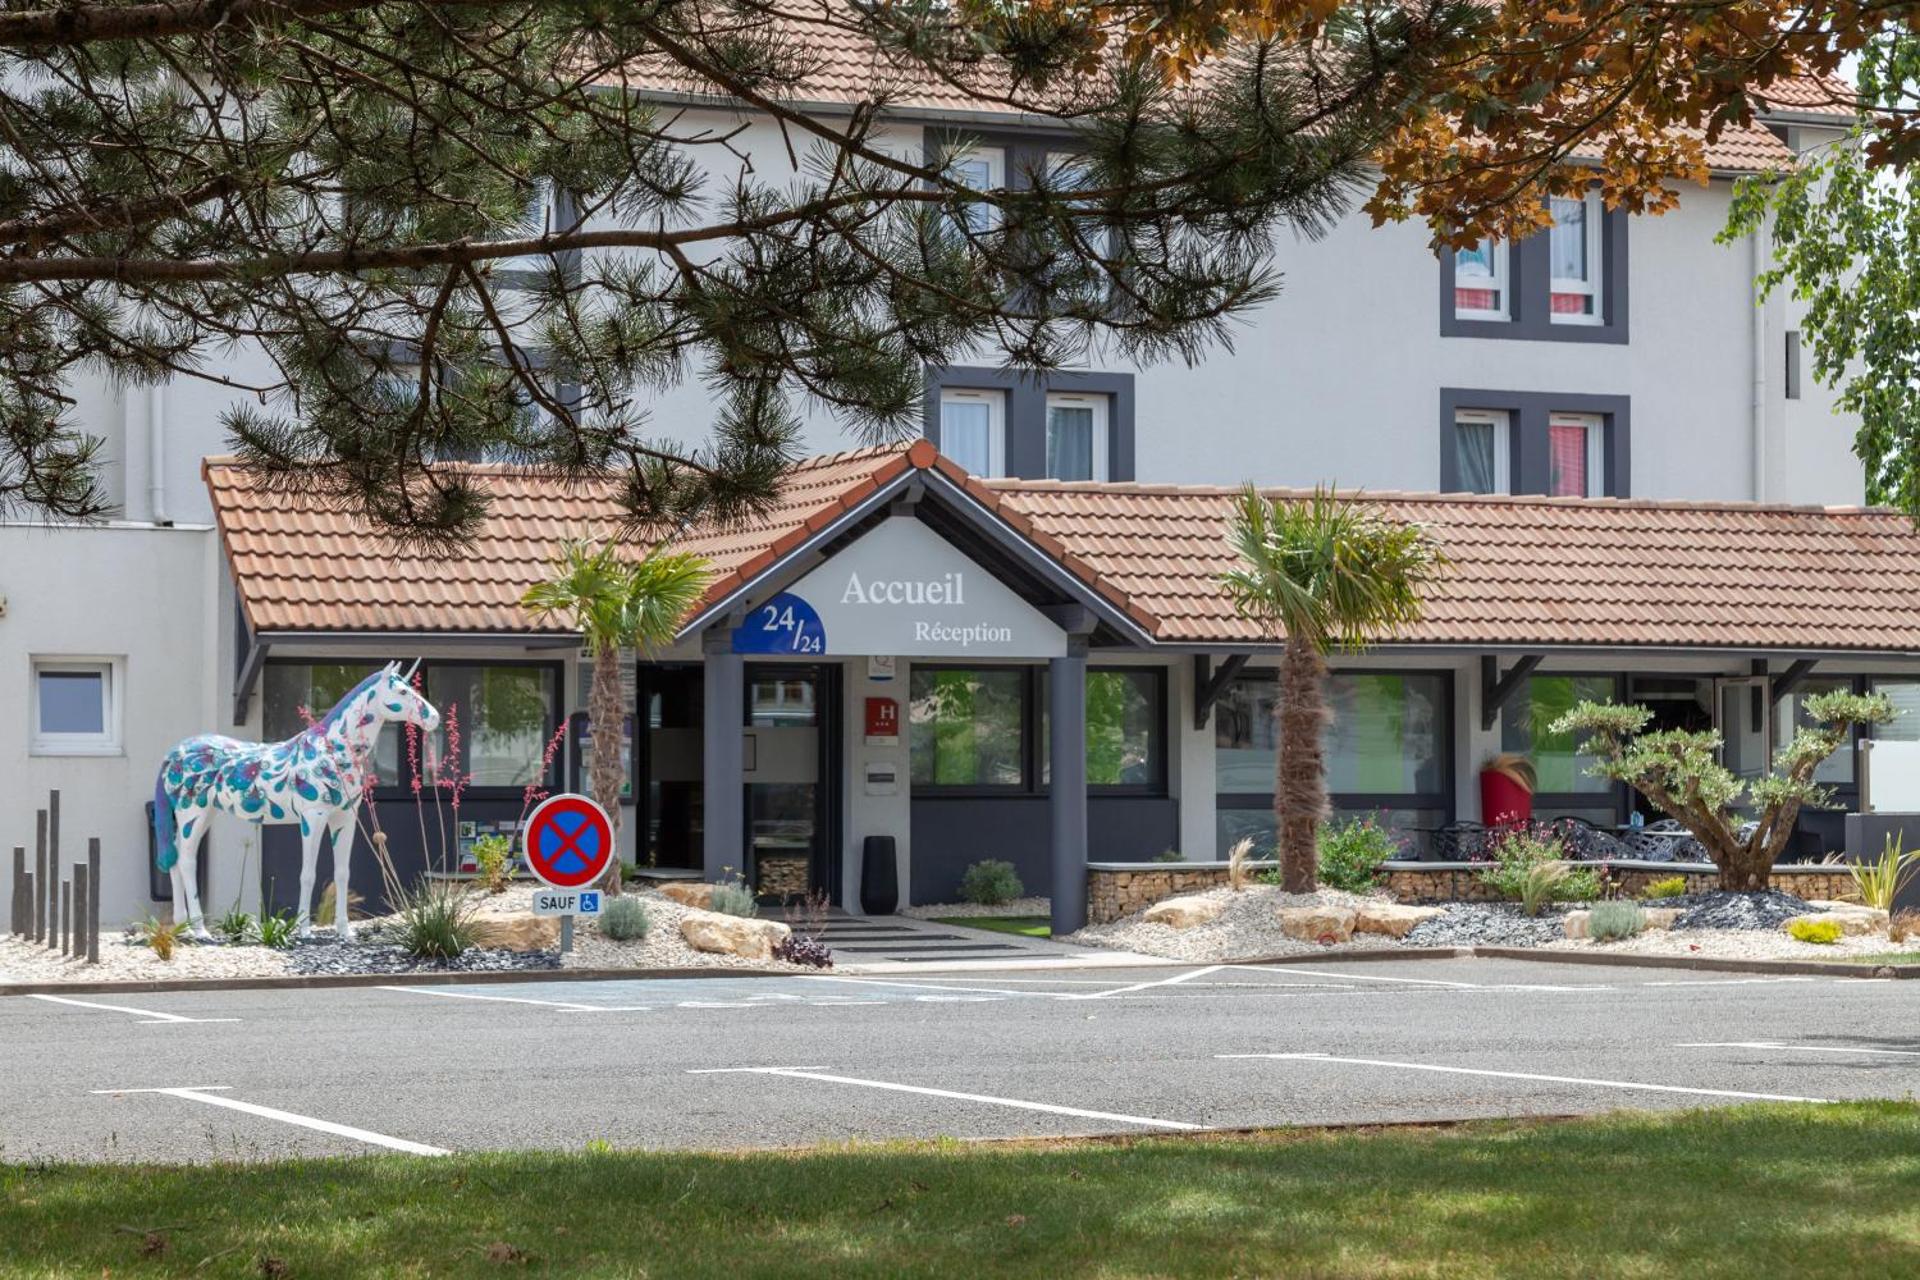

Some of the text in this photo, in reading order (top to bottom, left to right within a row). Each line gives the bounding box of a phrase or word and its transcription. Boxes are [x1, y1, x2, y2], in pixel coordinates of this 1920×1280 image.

[840, 571, 964, 605] Accueil
[915, 621, 1012, 647] Réception
[880, 705, 895, 719] H
[540, 896, 576, 910] SAUF
